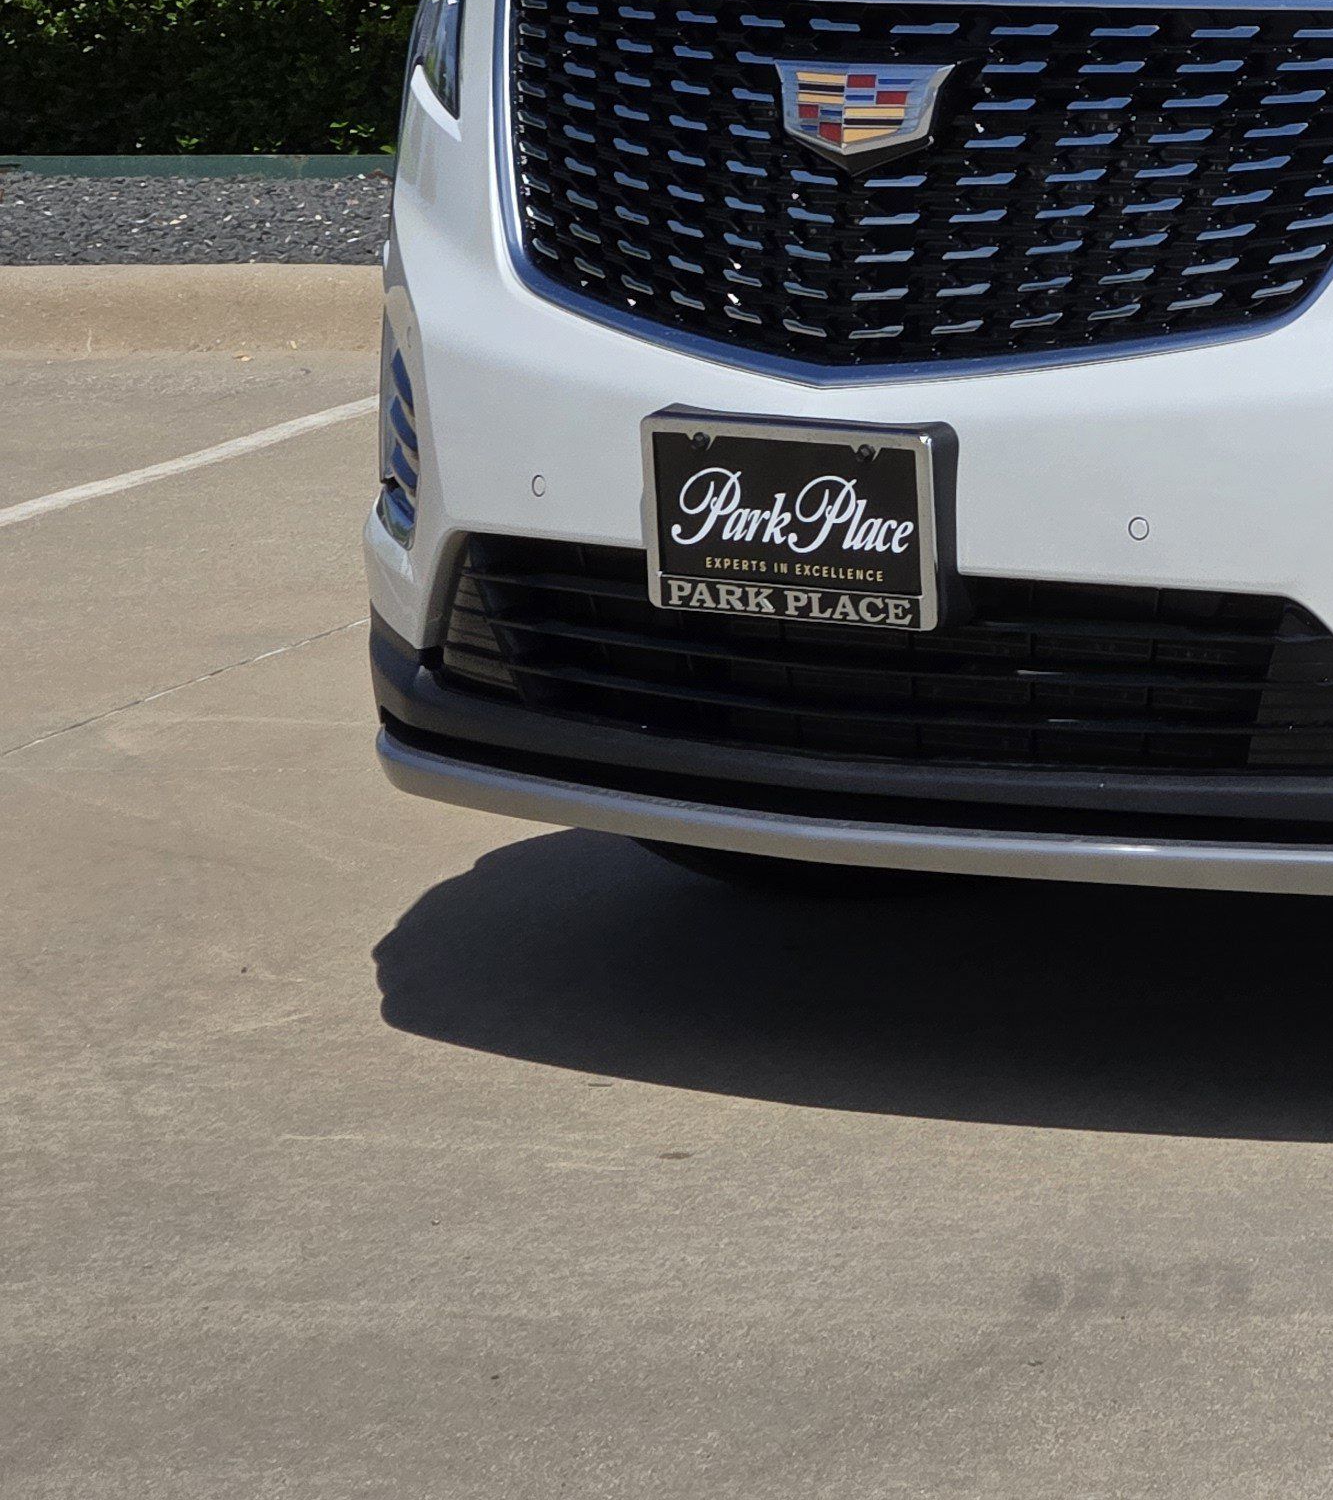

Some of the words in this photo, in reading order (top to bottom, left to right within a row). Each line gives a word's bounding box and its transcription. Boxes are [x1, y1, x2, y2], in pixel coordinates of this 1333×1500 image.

[671, 467, 792, 545] Park
[787, 475, 915, 554] Place
[705, 556, 767, 574] EXPERTS
[774, 562, 788, 574] IN
[795, 563, 884, 582] EXCELLENCE
[667, 579, 776, 614] PARK
[784, 590, 912, 626] PLACE
